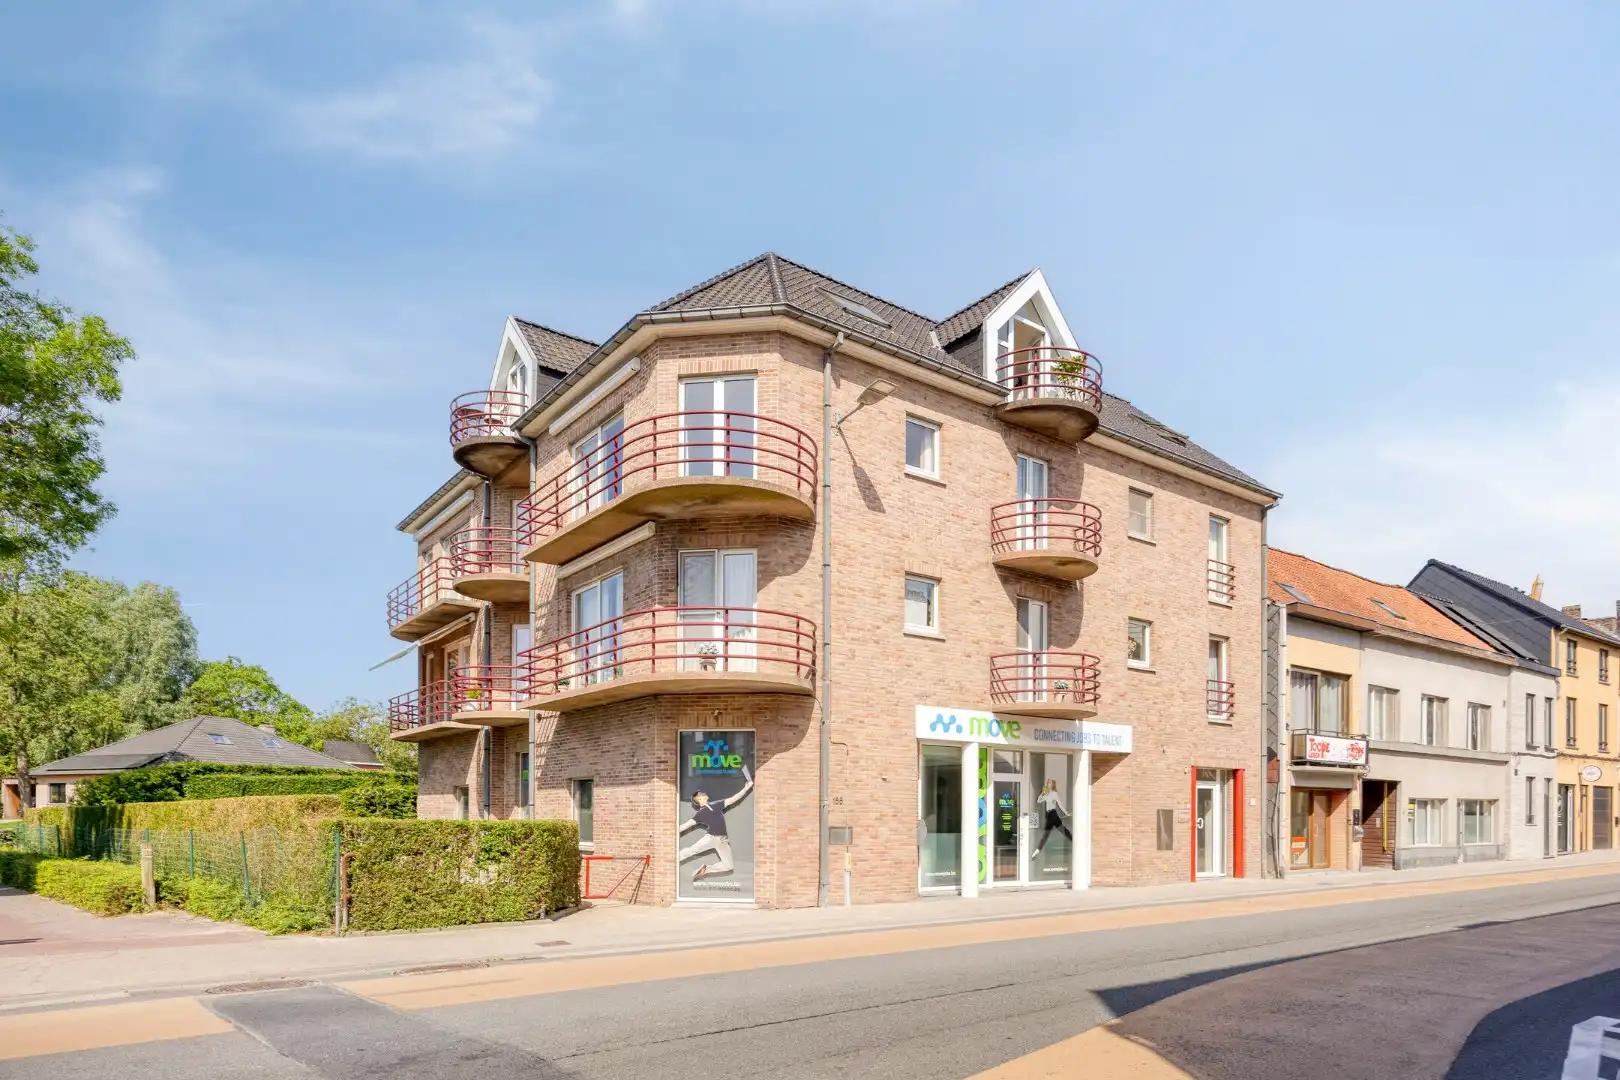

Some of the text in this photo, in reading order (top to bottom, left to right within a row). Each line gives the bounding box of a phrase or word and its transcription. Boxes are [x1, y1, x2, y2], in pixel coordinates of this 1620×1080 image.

[969, 716, 1022, 739] move
[1034, 728, 1123, 746] CONNECTING JOBS TO TALENT
[691, 754, 742, 768] move
